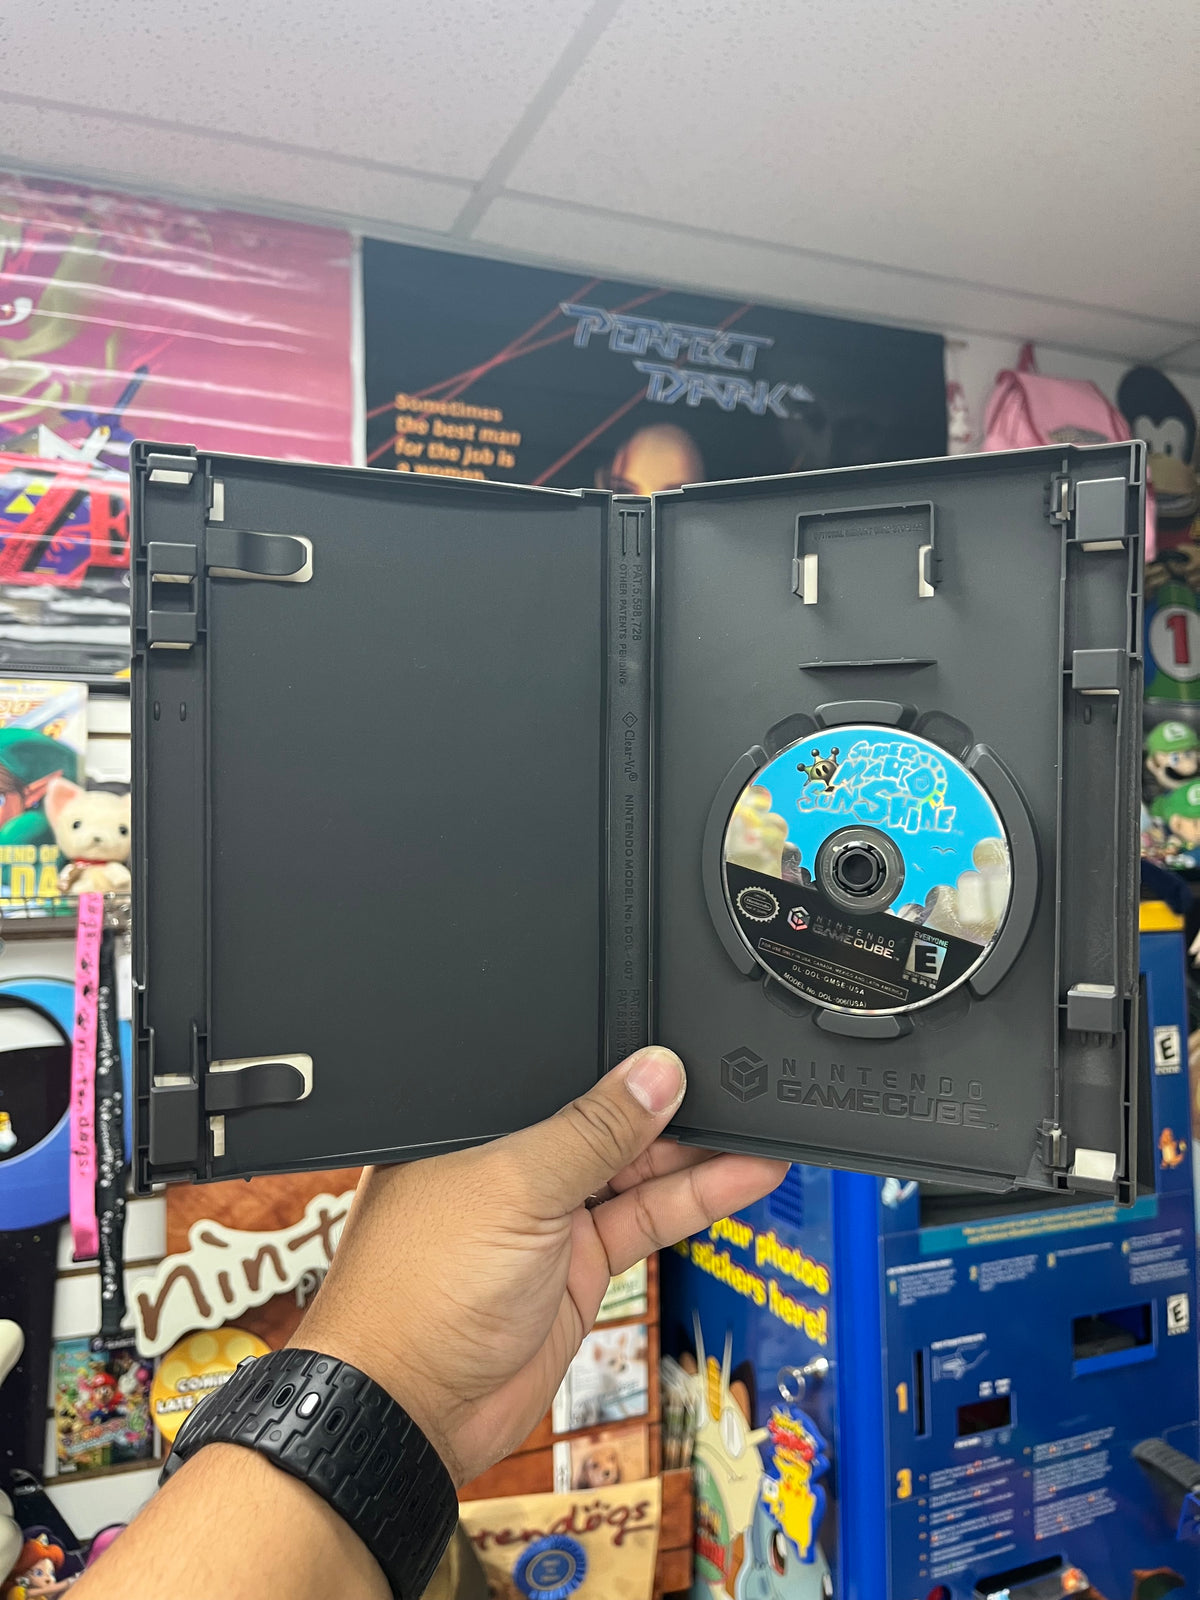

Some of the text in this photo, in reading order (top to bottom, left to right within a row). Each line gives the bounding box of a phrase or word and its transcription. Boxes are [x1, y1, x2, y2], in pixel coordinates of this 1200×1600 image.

[559, 302, 775, 370] PERFECT
[395, 393, 503, 423] Sometimes
[632, 360, 790, 419] DARK
[396, 415, 521, 446] the best man
[395, 438, 515, 469] for the job is
[619, 563, 628, 684] OTHER PATENTS PENDING
[1165, 613, 1190, 665] 1
[848, 740, 920, 762] SUPER
[828, 755, 938, 802] MARIO
[624, 794, 634, 857] NINTENDO
[797, 779, 957, 835] SUNSHINE
[624, 859, 633, 902] MODEL
[812, 923, 896, 960] GAMECUBE
[816, 915, 895, 948] NINTENDO
[914, 930, 949, 949] EVERYONE
[783, 971, 806, 990] MODEL
[914, 944, 938, 975] E
[781, 1057, 984, 1101] NINTENDO
[777, 1079, 989, 1129] GAMECUBE
[755, 1230, 831, 1296] photos
[690, 1240, 767, 1307] stickers
[768, 1278, 828, 1346] here!
[156, 1395, 194, 1415] LATE
[896, 1381, 908, 1413] 1
[896, 1468, 912, 1498] 3
[471, 1501, 656, 1547] tendogs
